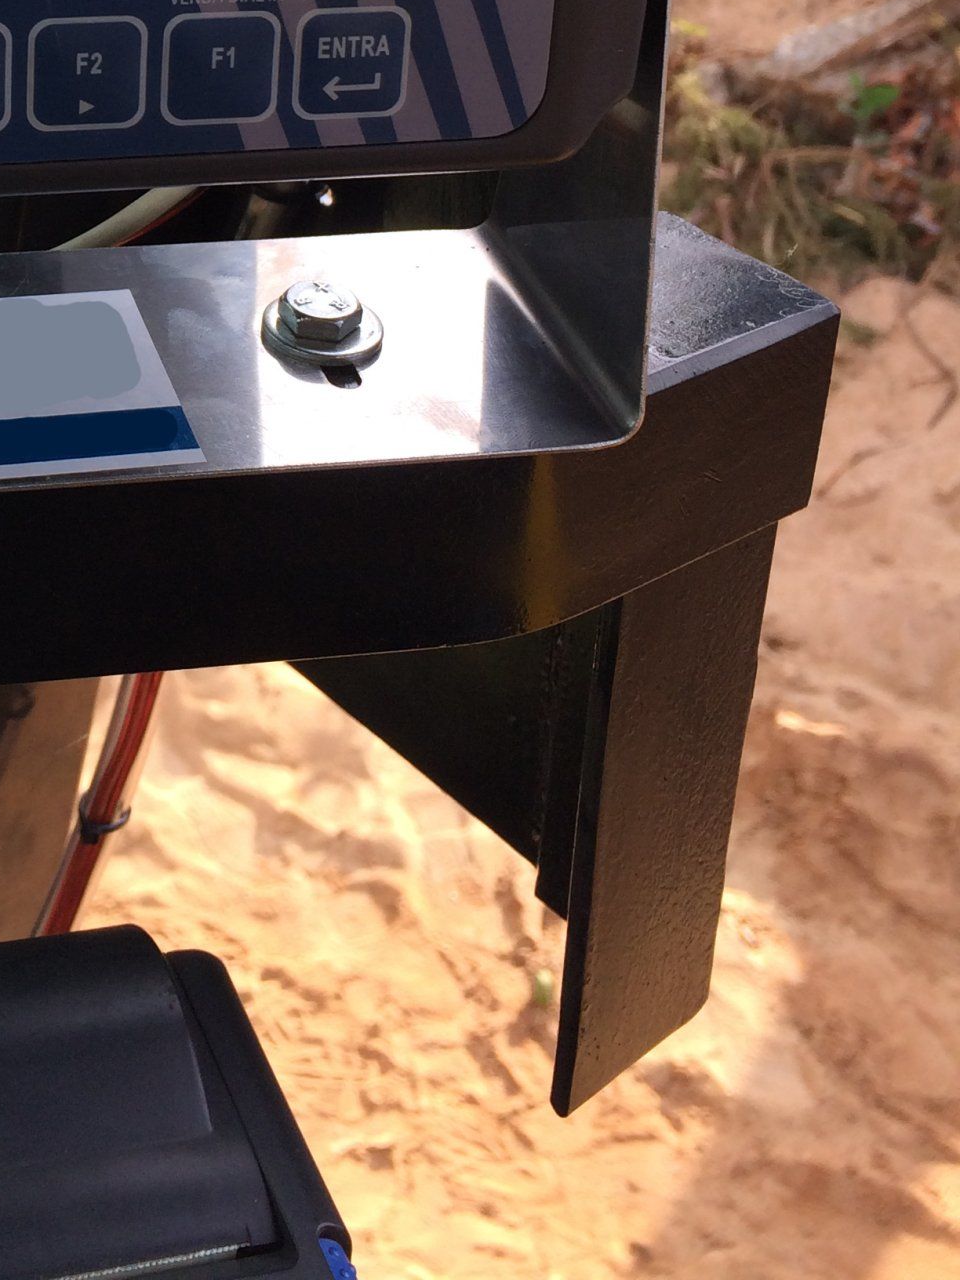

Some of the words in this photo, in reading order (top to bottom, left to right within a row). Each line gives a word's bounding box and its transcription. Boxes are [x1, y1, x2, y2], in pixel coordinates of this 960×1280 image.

[212, 46, 236, 69] F1
[318, 35, 390, 59] ENTRA
[76, 53, 102, 75] F2
